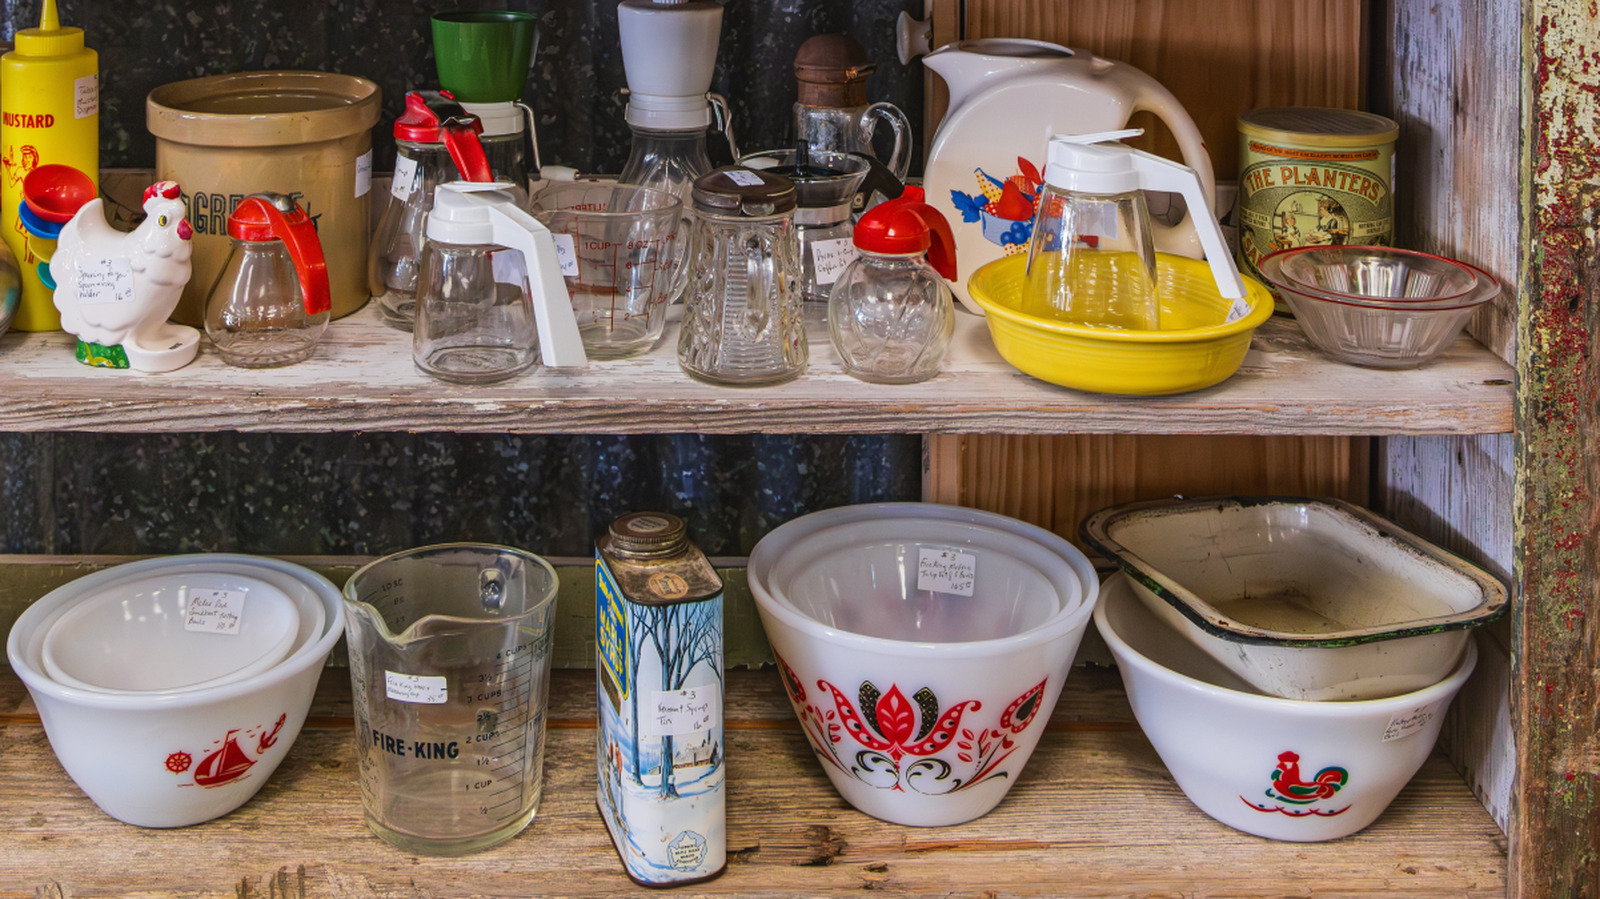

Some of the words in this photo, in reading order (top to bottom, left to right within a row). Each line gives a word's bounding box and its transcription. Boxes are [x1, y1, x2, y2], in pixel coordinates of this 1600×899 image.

[3, 112, 54, 128] MUSTARD
[1246, 168, 1275, 192] THE
[1280, 166, 1380, 201] PLANTERS
[477, 690, 502, 701] CUPS
[475, 731, 500, 742] CUPS
[474, 780, 493, 790] CUP
